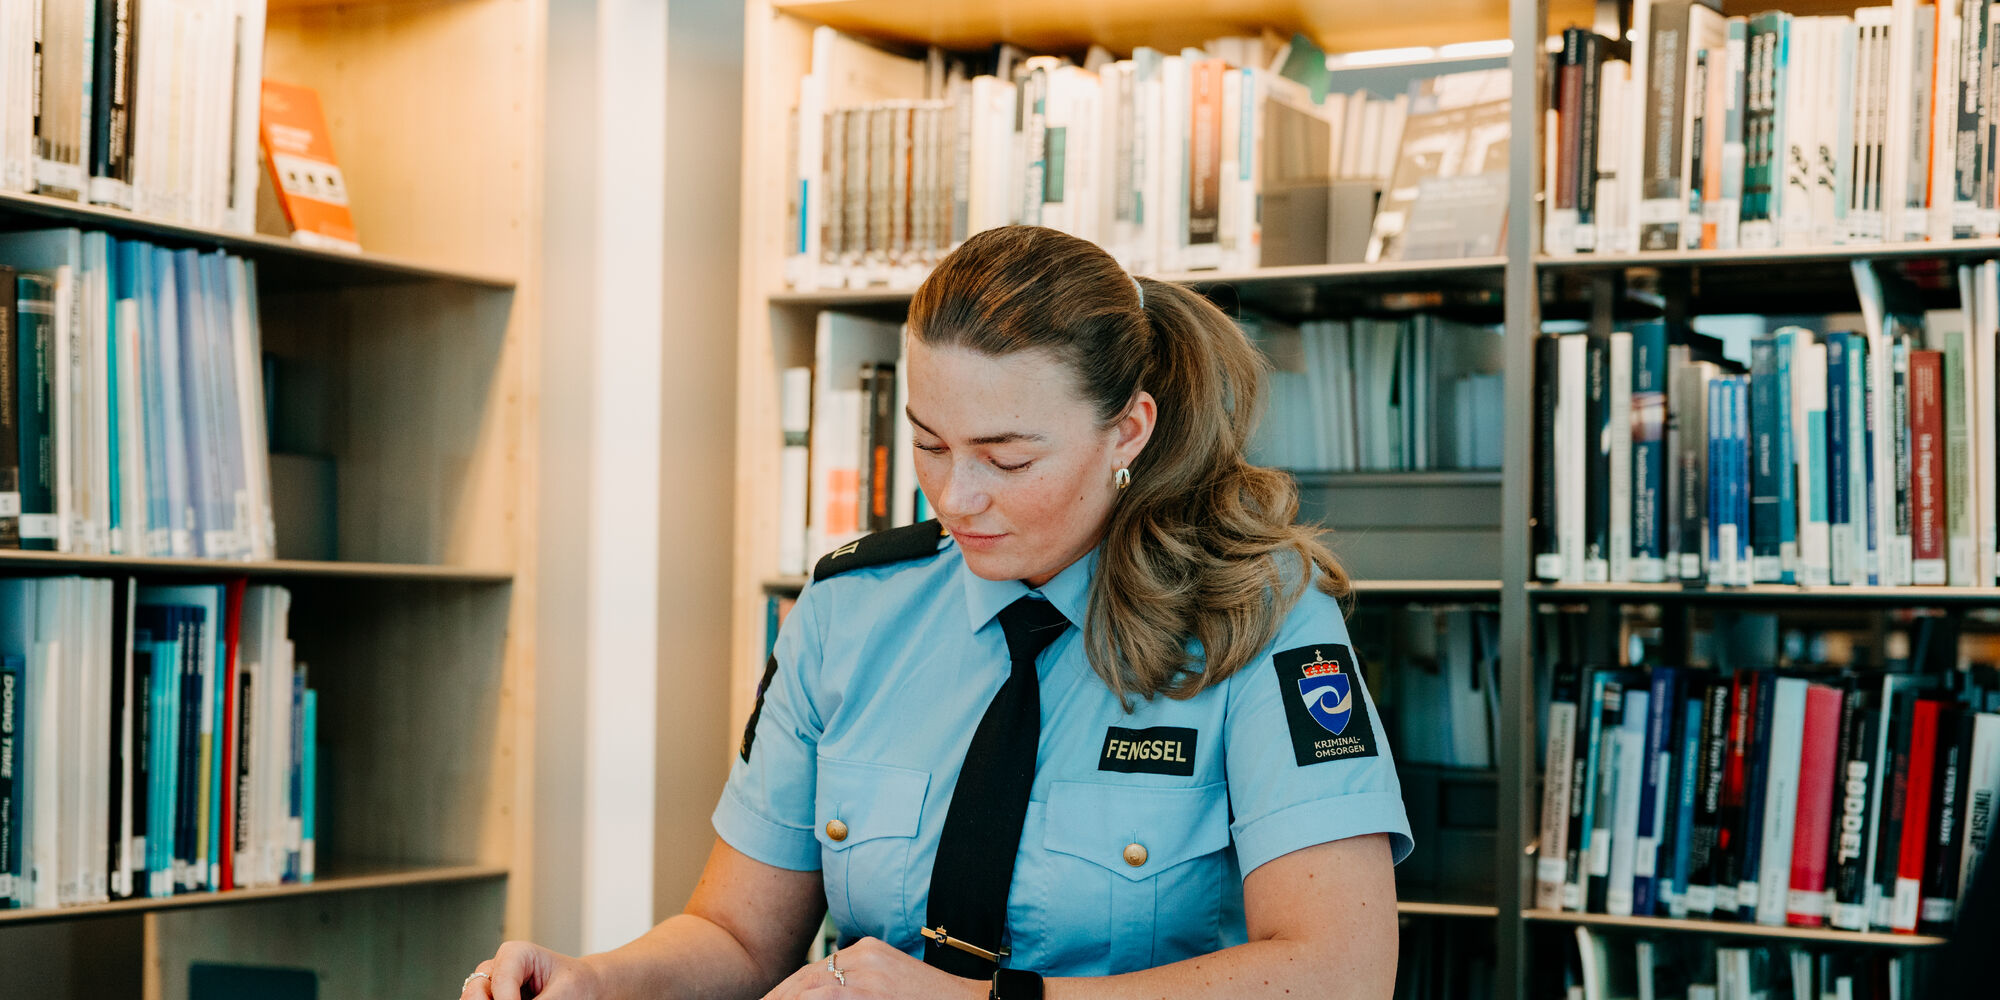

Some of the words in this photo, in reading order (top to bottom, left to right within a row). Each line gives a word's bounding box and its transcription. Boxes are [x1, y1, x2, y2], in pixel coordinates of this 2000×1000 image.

[2, 674, 15, 734] DOING
[1106, 739, 1187, 763] FENGSEL
[1314, 736, 1361, 749] KRIMINAL-
[1315, 745, 1365, 758] OMSORGEN
[1, 738, 14, 779] TIME
